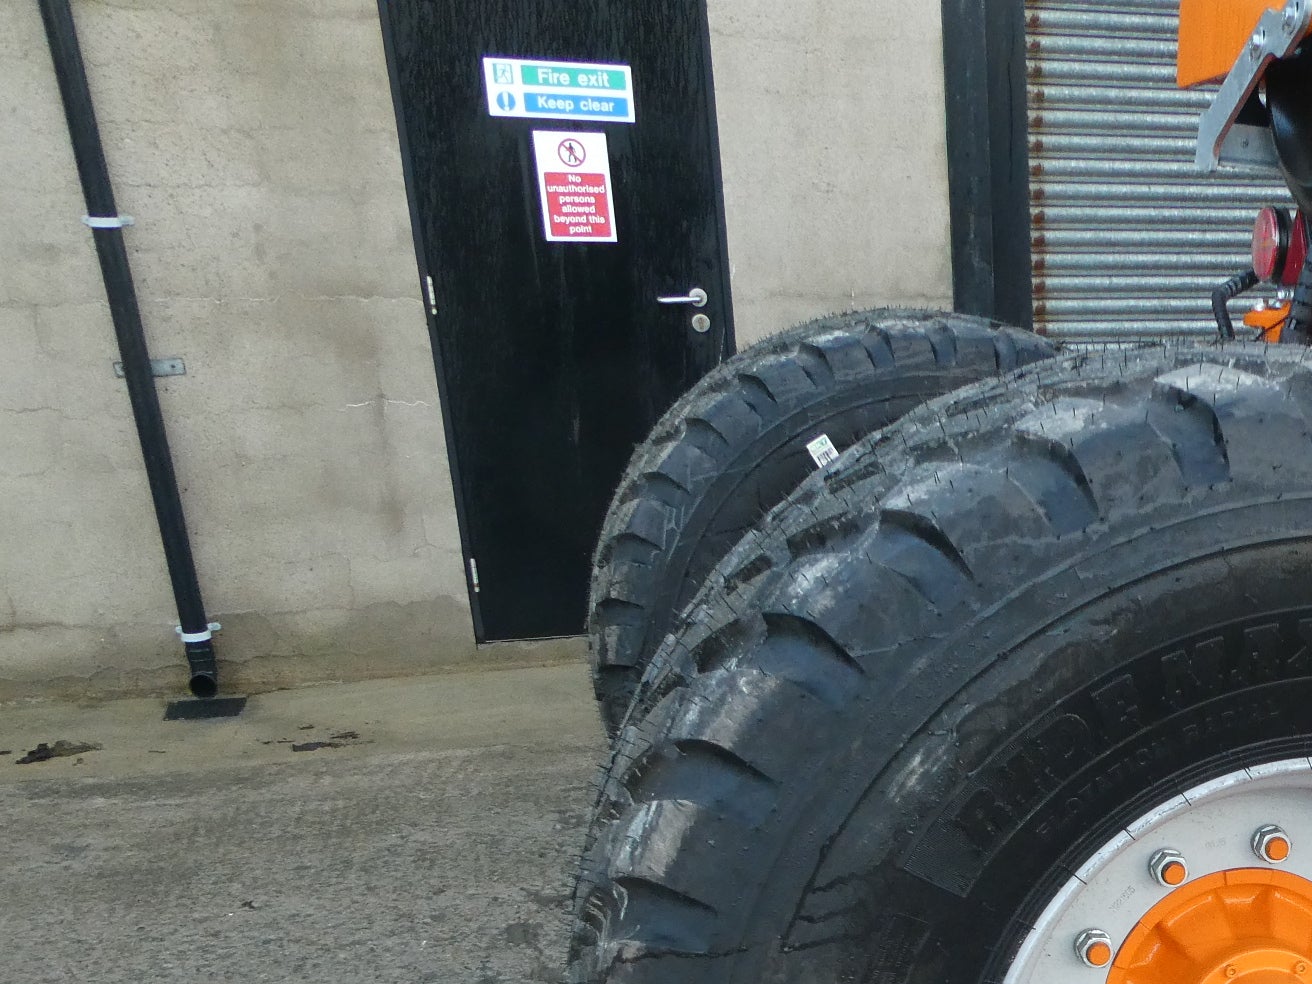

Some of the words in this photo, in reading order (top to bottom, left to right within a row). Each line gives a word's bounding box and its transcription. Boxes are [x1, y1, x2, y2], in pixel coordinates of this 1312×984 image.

[537, 68, 571, 86] Fire
[577, 72, 610, 88] exit
[537, 95, 575, 112] Keep
[580, 98, 615, 112] clear
[567, 174, 582, 183] No
[547, 184, 606, 194] unauthorised
[558, 195, 596, 205] persons
[561, 204, 596, 213] allowed
[553, 214, 587, 225] beyond
[588, 215, 606, 224] this
[568, 224, 593, 235] point
